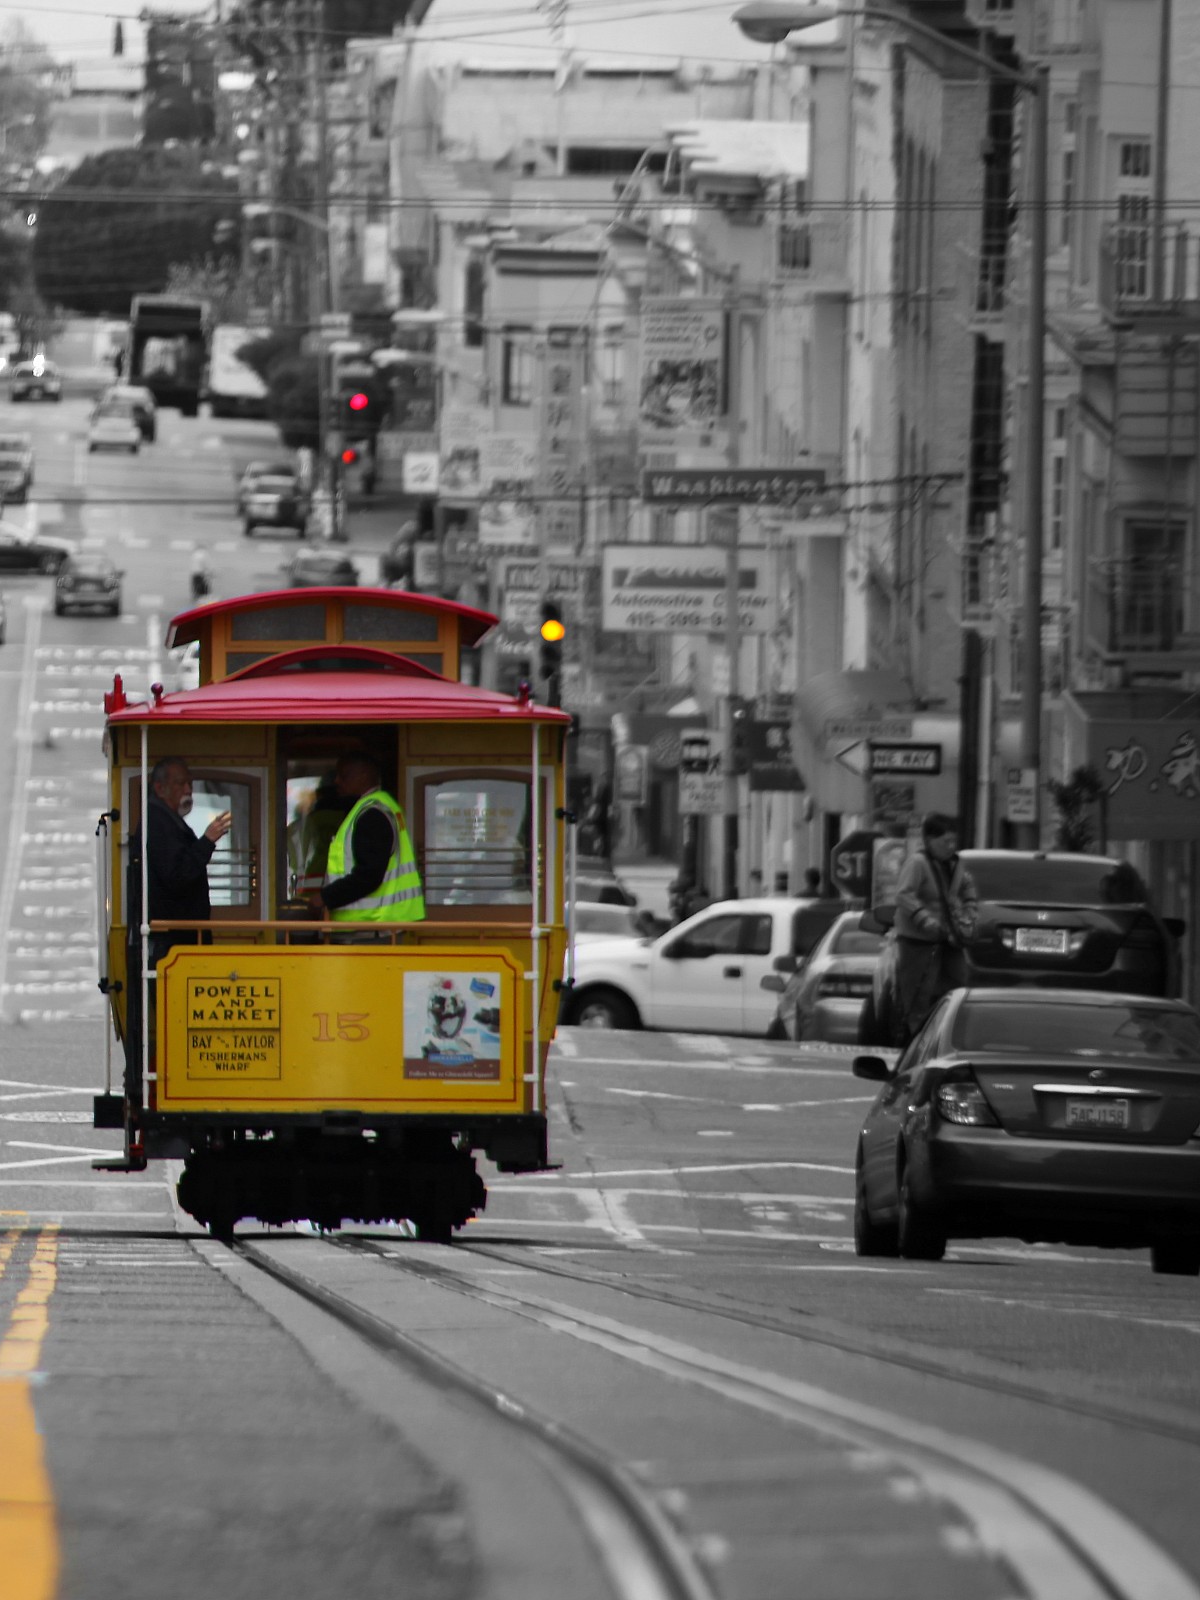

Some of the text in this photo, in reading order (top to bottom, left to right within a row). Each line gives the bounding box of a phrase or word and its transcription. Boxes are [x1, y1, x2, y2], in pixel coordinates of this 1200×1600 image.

[713, 592, 768, 608] Cnter
[836, 851, 869, 879] ST
[193, 985, 275, 998] POWELL
[215, 998, 255, 1008] AND
[192, 1009, 276, 1020] MARKET
[312, 1012, 371, 1041] 15
[191, 1034, 212, 1048] BAY
[232, 1034, 275, 1049] TAYLOR
[199, 1051, 267, 1061] FISHERMANS
[215, 1062, 249, 1071] WHARF
